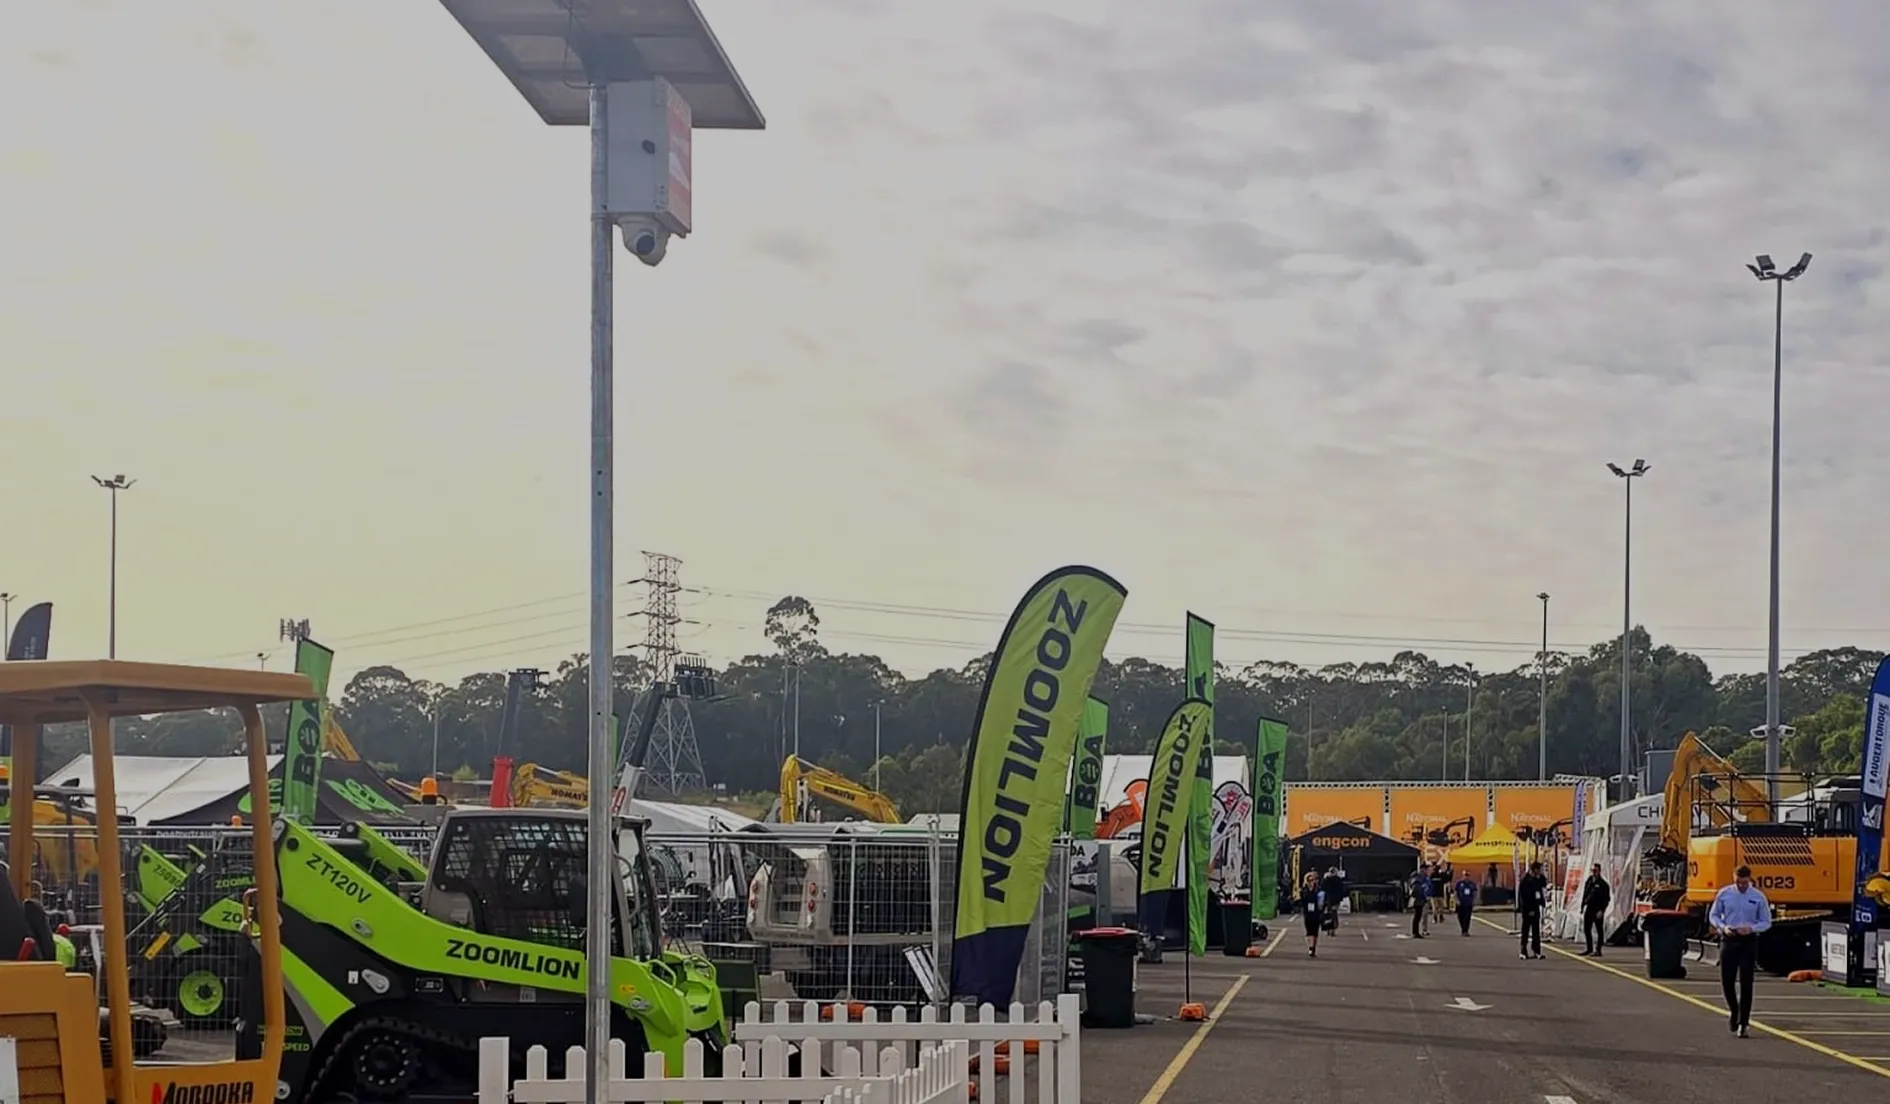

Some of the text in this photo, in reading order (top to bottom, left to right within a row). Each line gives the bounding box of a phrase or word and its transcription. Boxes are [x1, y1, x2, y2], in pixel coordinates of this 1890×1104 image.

[981, 587, 1088, 903] ZOOMLION
[1074, 734, 1104, 811] BOA
[1149, 713, 1197, 878] ZOOMLION
[1257, 751, 1280, 816] BOA
[1312, 836, 1370, 850] engcon
[306, 853, 372, 903] ZT120V
[446, 939, 580, 980] ZOOMLION
